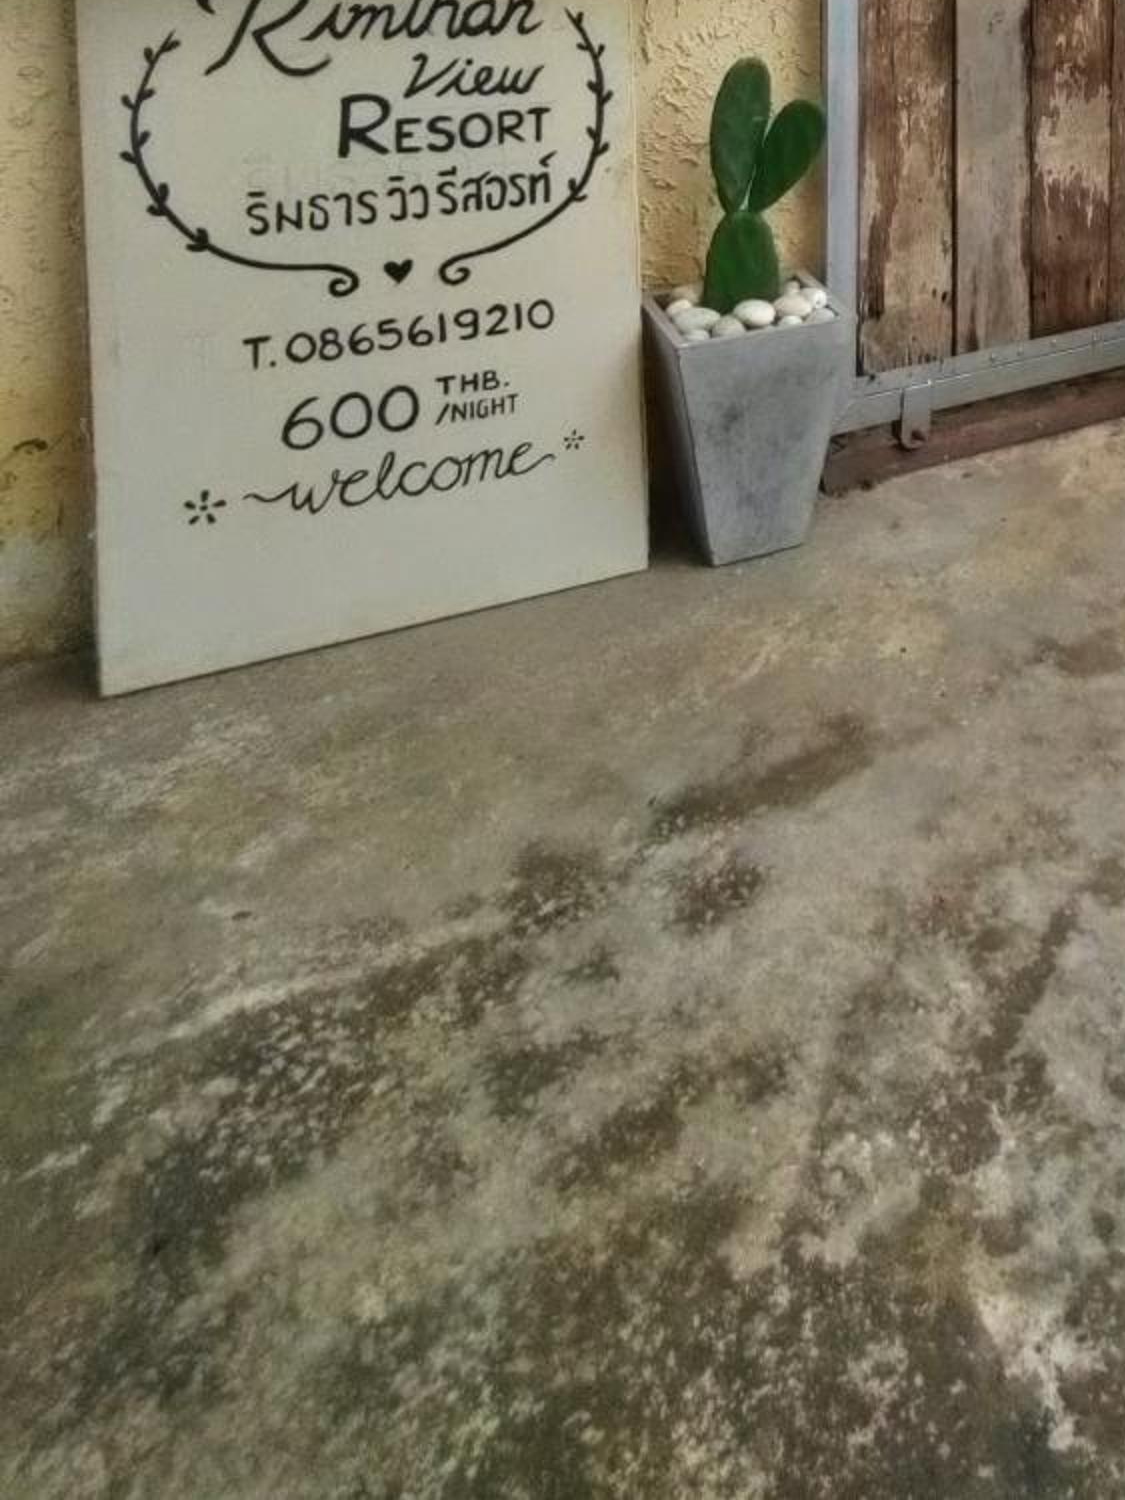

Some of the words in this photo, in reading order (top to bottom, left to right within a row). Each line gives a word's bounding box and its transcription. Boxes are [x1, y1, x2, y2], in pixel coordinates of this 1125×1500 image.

[404, 53, 545, 99] View
[338, 93, 551, 158] RESORT
[281, 385, 420, 450] 600
[436, 369, 510, 396] THB.
[434, 393, 519, 426] /NIGHT
[243, 442, 555, 515] welcome
